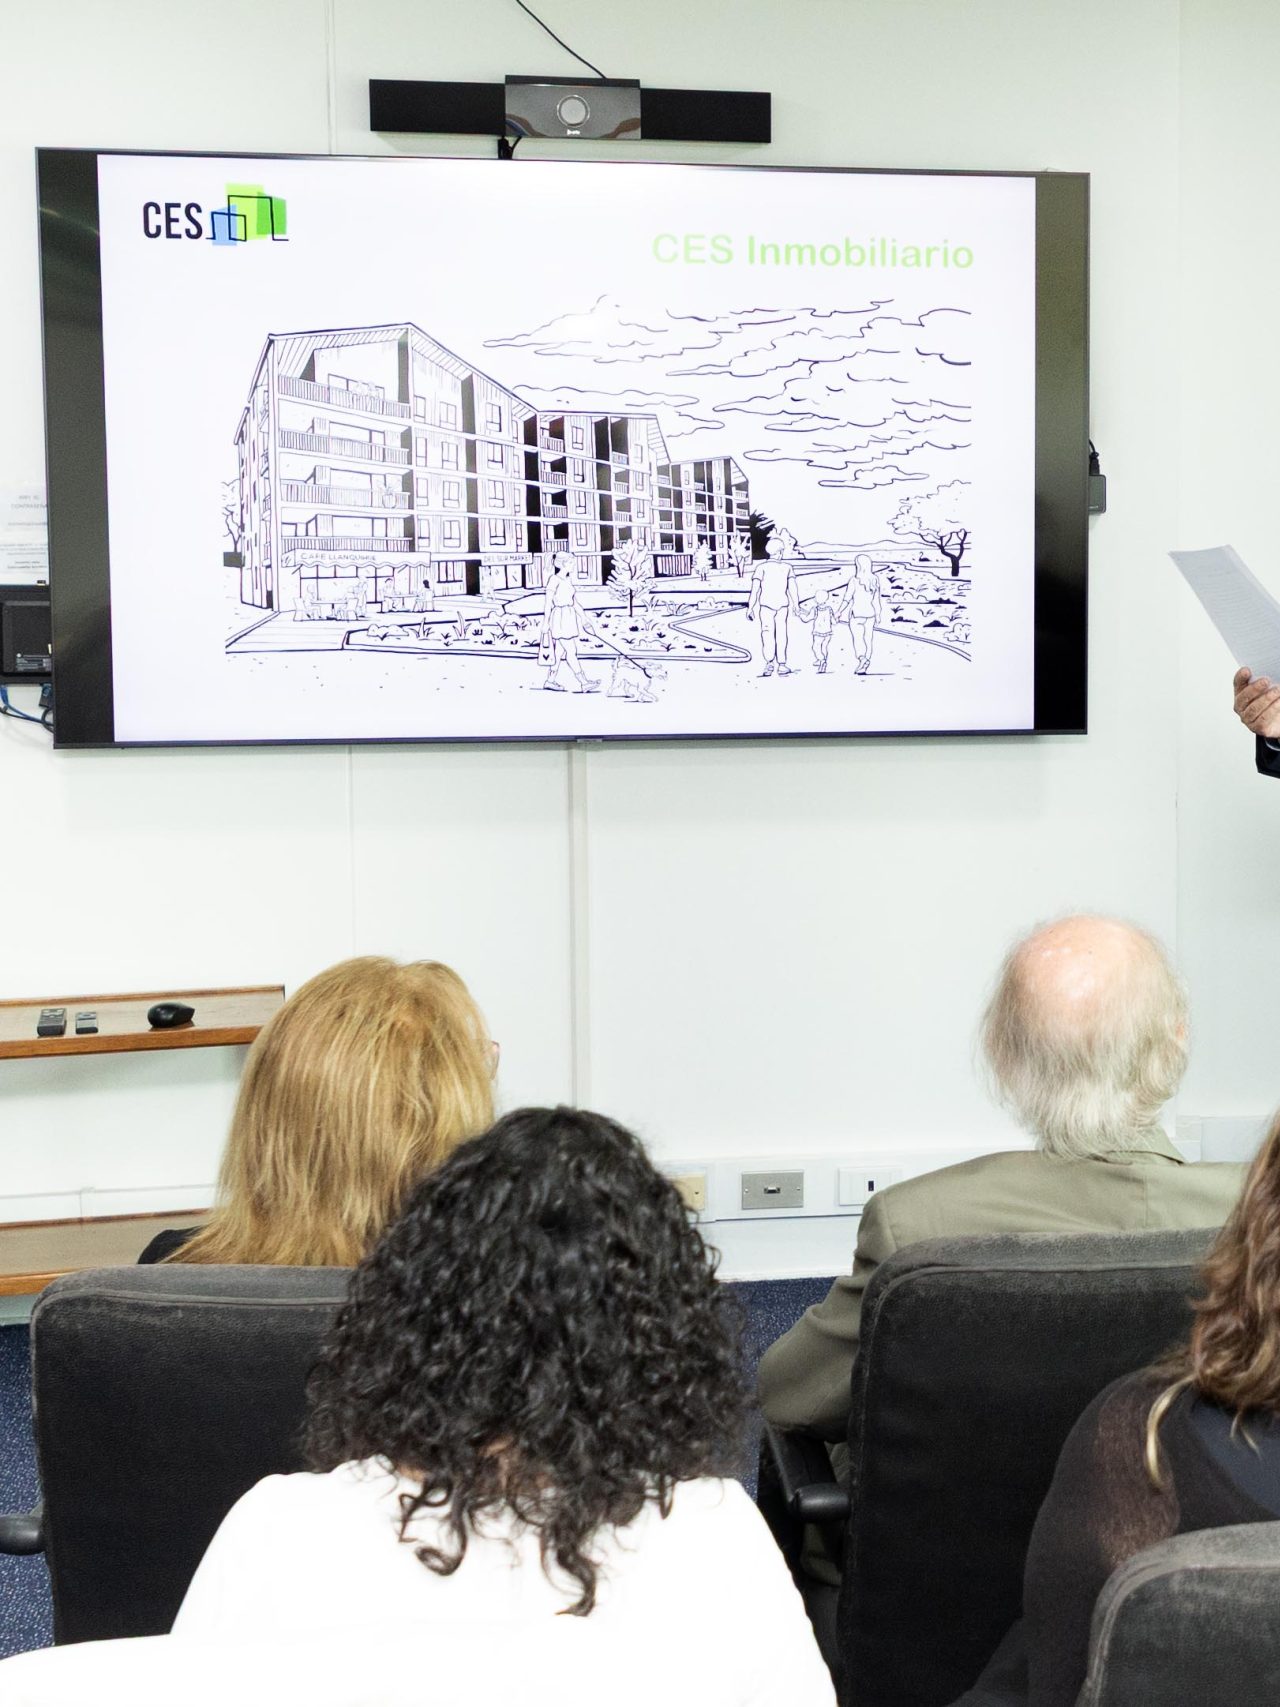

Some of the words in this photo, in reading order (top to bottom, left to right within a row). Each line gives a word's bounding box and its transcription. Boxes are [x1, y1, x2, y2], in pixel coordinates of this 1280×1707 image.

[143, 201, 203, 240] CES
[652, 232, 734, 265] CES
[748, 234, 975, 270] Inmobiliario
